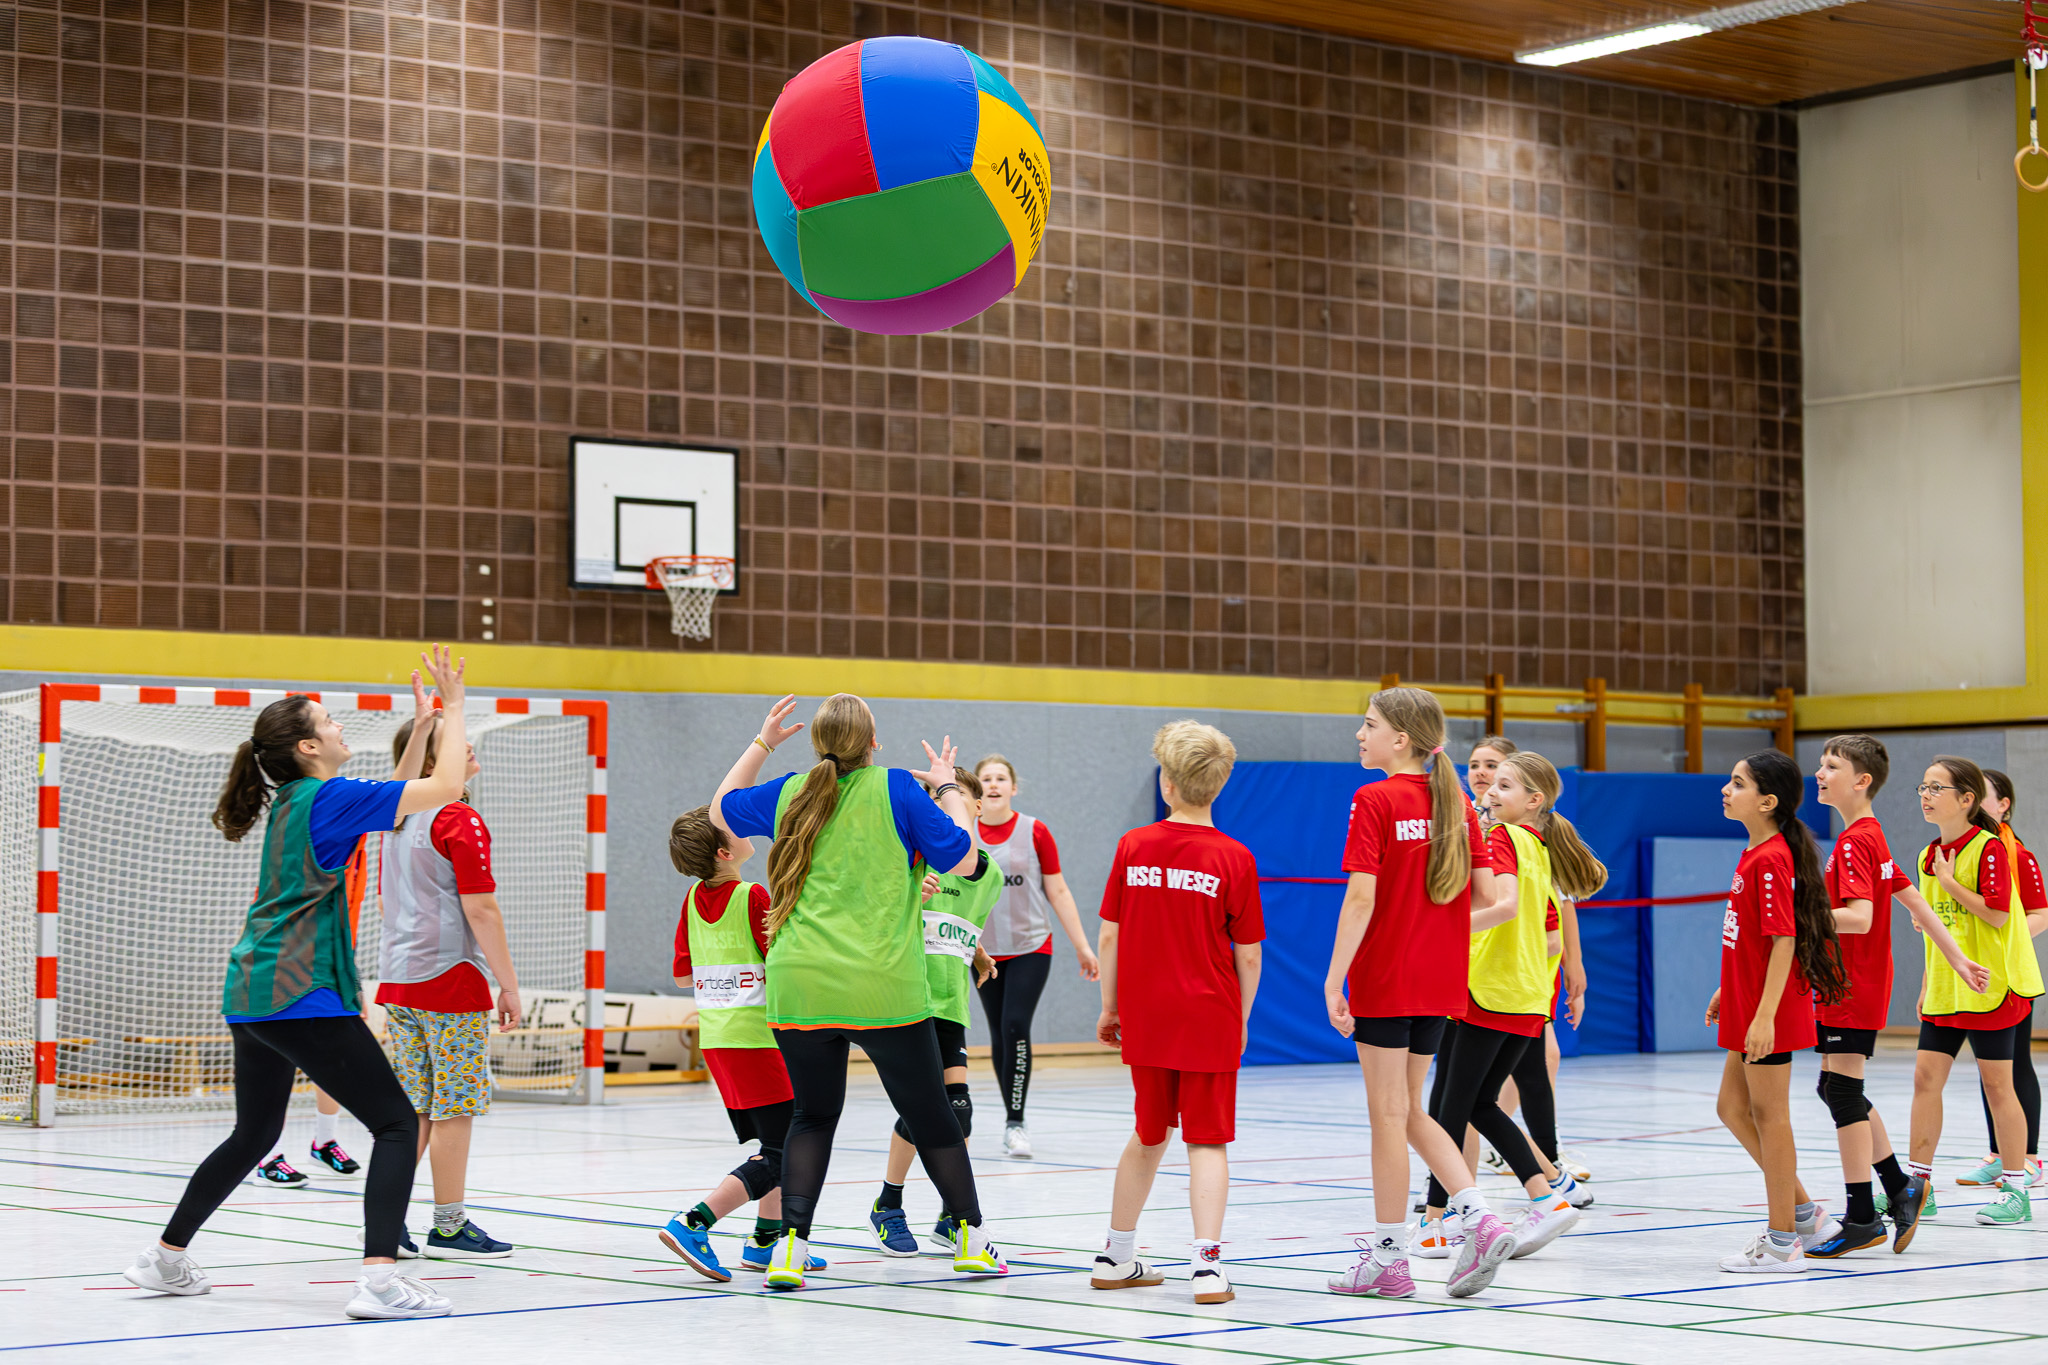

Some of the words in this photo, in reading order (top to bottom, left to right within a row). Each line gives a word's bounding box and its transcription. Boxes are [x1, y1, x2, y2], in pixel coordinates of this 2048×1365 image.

[942, 886, 960, 897] JAKO
[1003, 875, 1024, 887] KO
[1127, 866, 1162, 887] HSG
[1166, 868, 1220, 898] WESEL
[1011, 1073, 1025, 1111] OCEANS
